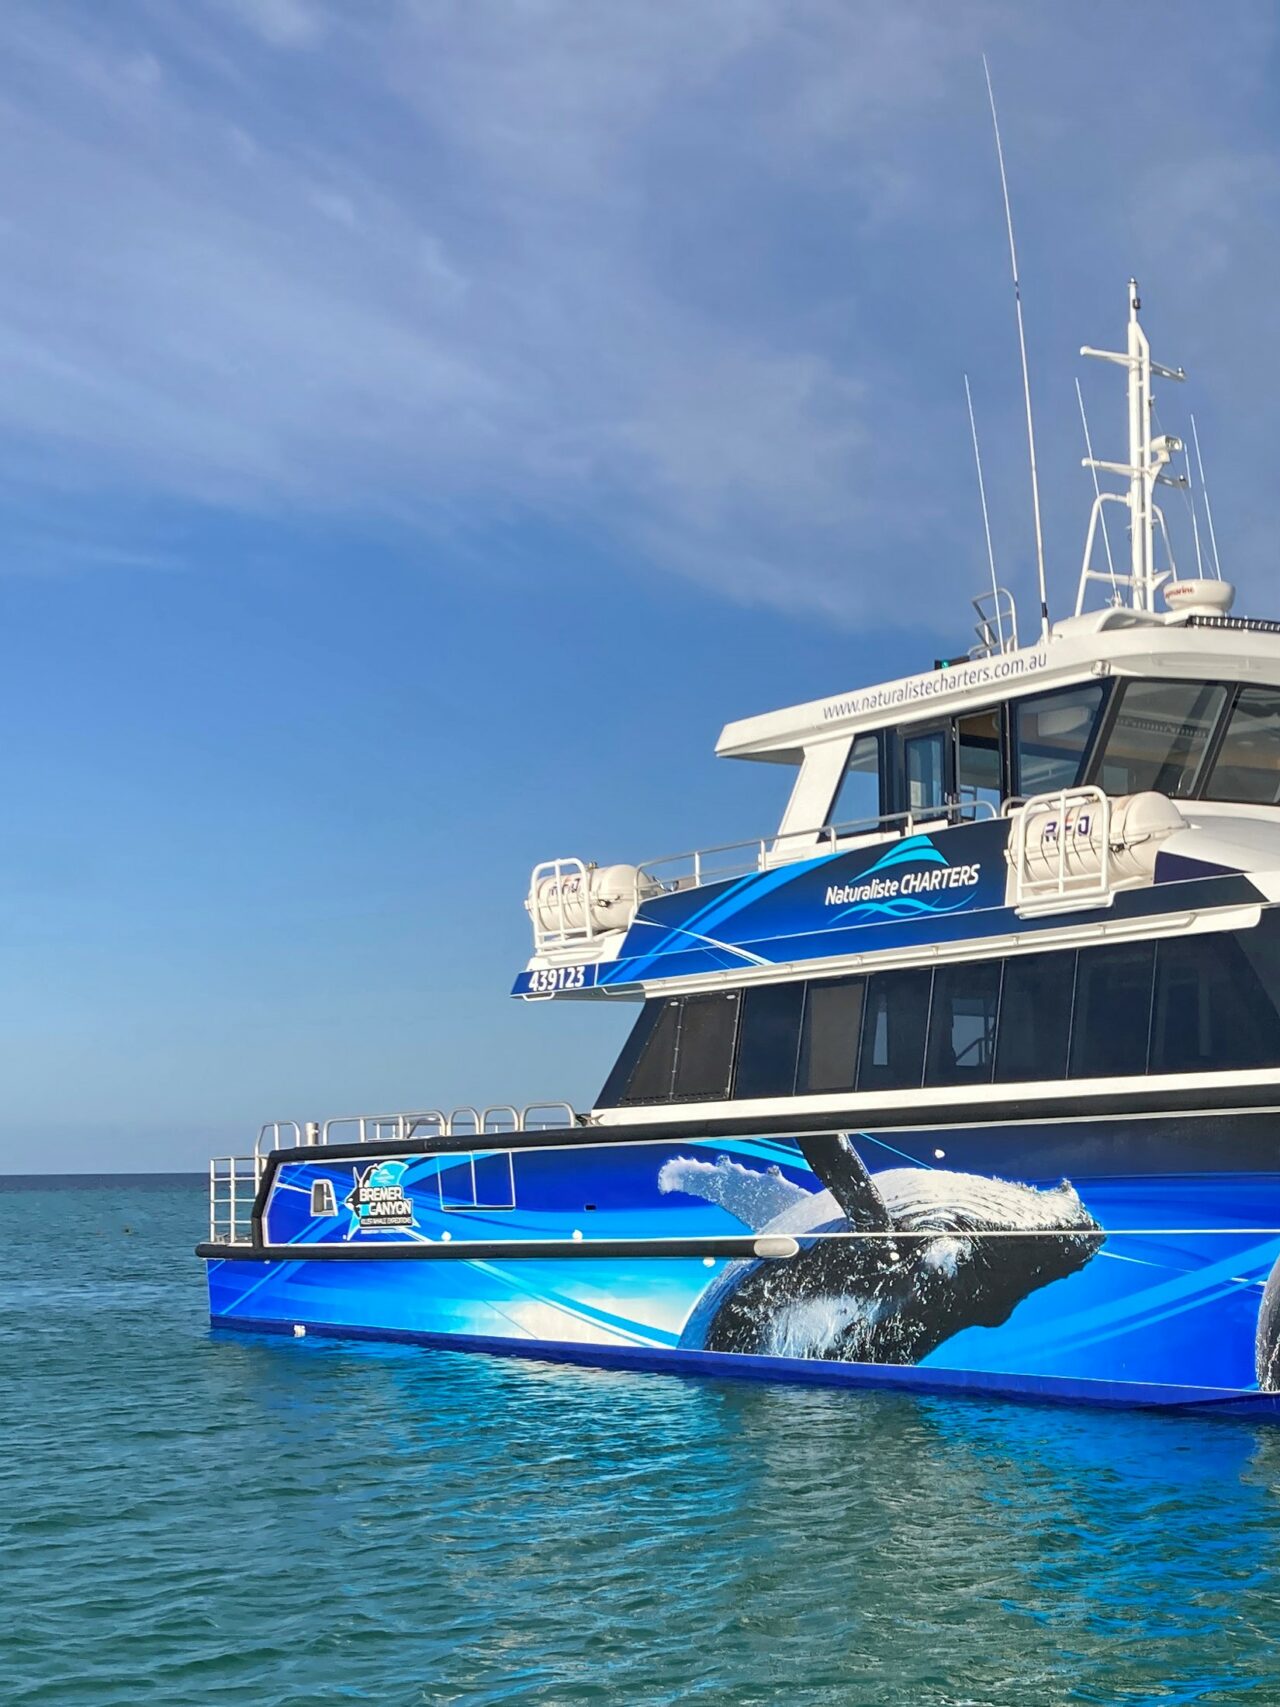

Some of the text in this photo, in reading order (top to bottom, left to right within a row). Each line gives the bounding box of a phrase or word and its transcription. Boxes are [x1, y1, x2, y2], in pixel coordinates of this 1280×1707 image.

[823, 652, 1047, 719] www.naturalistecharters.com.au
[825, 863, 981, 905] Naturaliste CHARTERS
[528, 965, 586, 992] 439123
[359, 1186, 403, 1202] BREMER
[369, 1200, 412, 1216] CANYON
